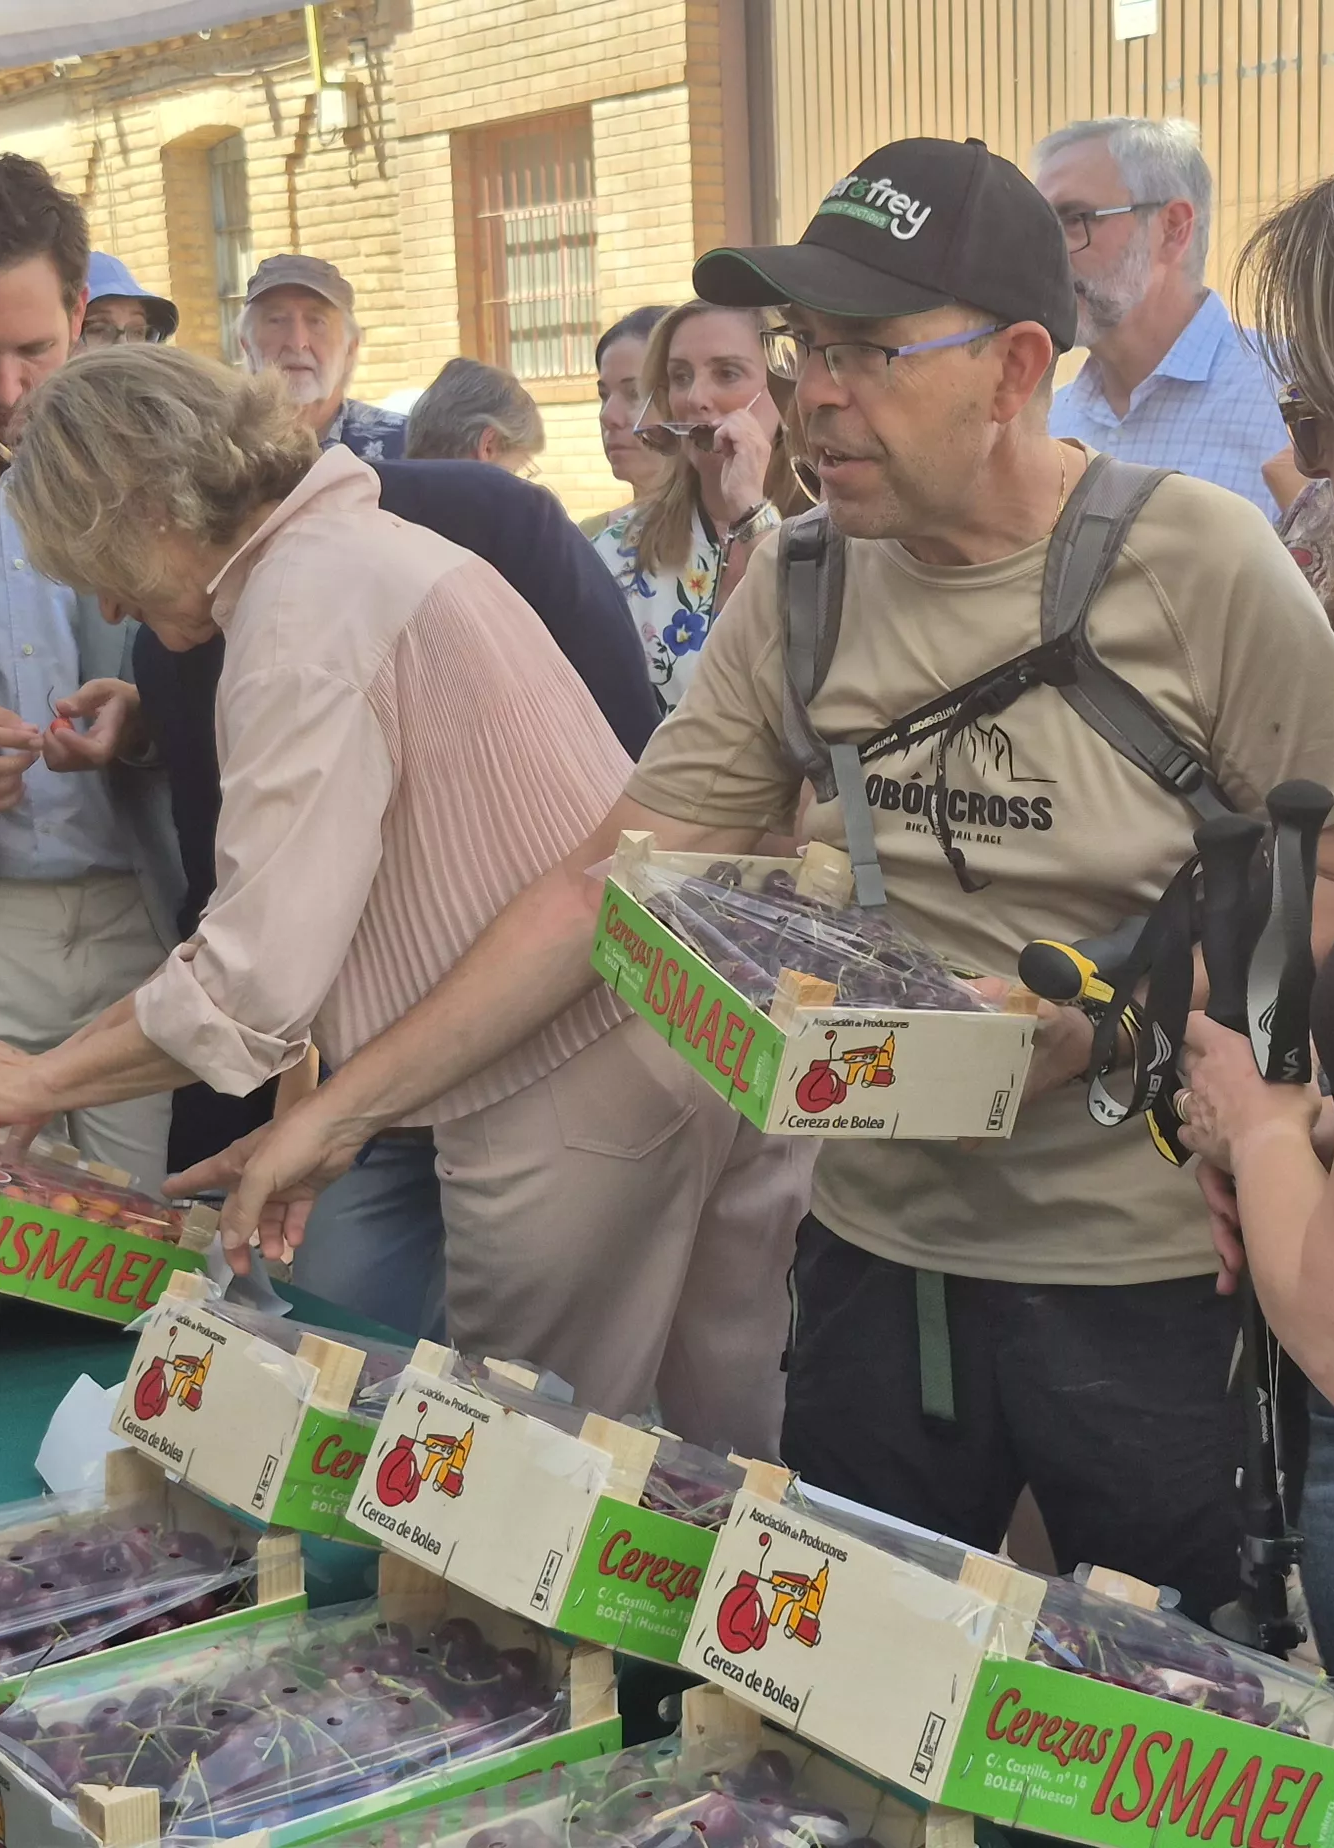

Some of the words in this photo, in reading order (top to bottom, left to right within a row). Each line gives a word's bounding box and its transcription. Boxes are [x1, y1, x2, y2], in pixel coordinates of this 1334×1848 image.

[905, 821, 928, 834] BIKE
[950, 829, 972, 842] RAIL
[976, 833, 1003, 846] RACE
[605, 904, 653, 968] Cerezas
[644, 947, 755, 1093] ISMAEL
[863, 1019, 910, 1029] Productores
[788, 1116, 830, 1129] Cereza
[832, 1115, 848, 1129] de
[851, 1116, 885, 1129] Bolea
[451, 1398, 491, 1424] Productores
[122, 1416, 149, 1444] Cereza
[148, 1430, 161, 1448] de
[159, 1436, 184, 1464] Bolea
[311, 1434, 368, 1481] Cer
[362, 1502, 396, 1531] Cereza
[396, 1519, 412, 1539] de
[411, 1525, 442, 1556] Bolea
[749, 1508, 792, 1537] Asociación
[798, 1529, 849, 1563] Productores
[596, 1604, 633, 1624] BOLEA
[634, 1615, 682, 1641] (Huesca)
[616, 1592, 659, 1616] Castilla,
[703, 1646, 745, 1684] Cereza
[745, 1669, 763, 1692] de
[763, 1677, 800, 1714] Bolea
[986, 1688, 1113, 1768] Cerezas
[1091, 1724, 1323, 1848] ISMAEL
[986, 1753, 1002, 1769] C/.
[1006, 1758, 1053, 1783] Castilla,
[1073, 1774, 1087, 1789] 18
[984, 1773, 1025, 1795] BOLEA
[1027, 1783, 1078, 1810] (Huesca)
